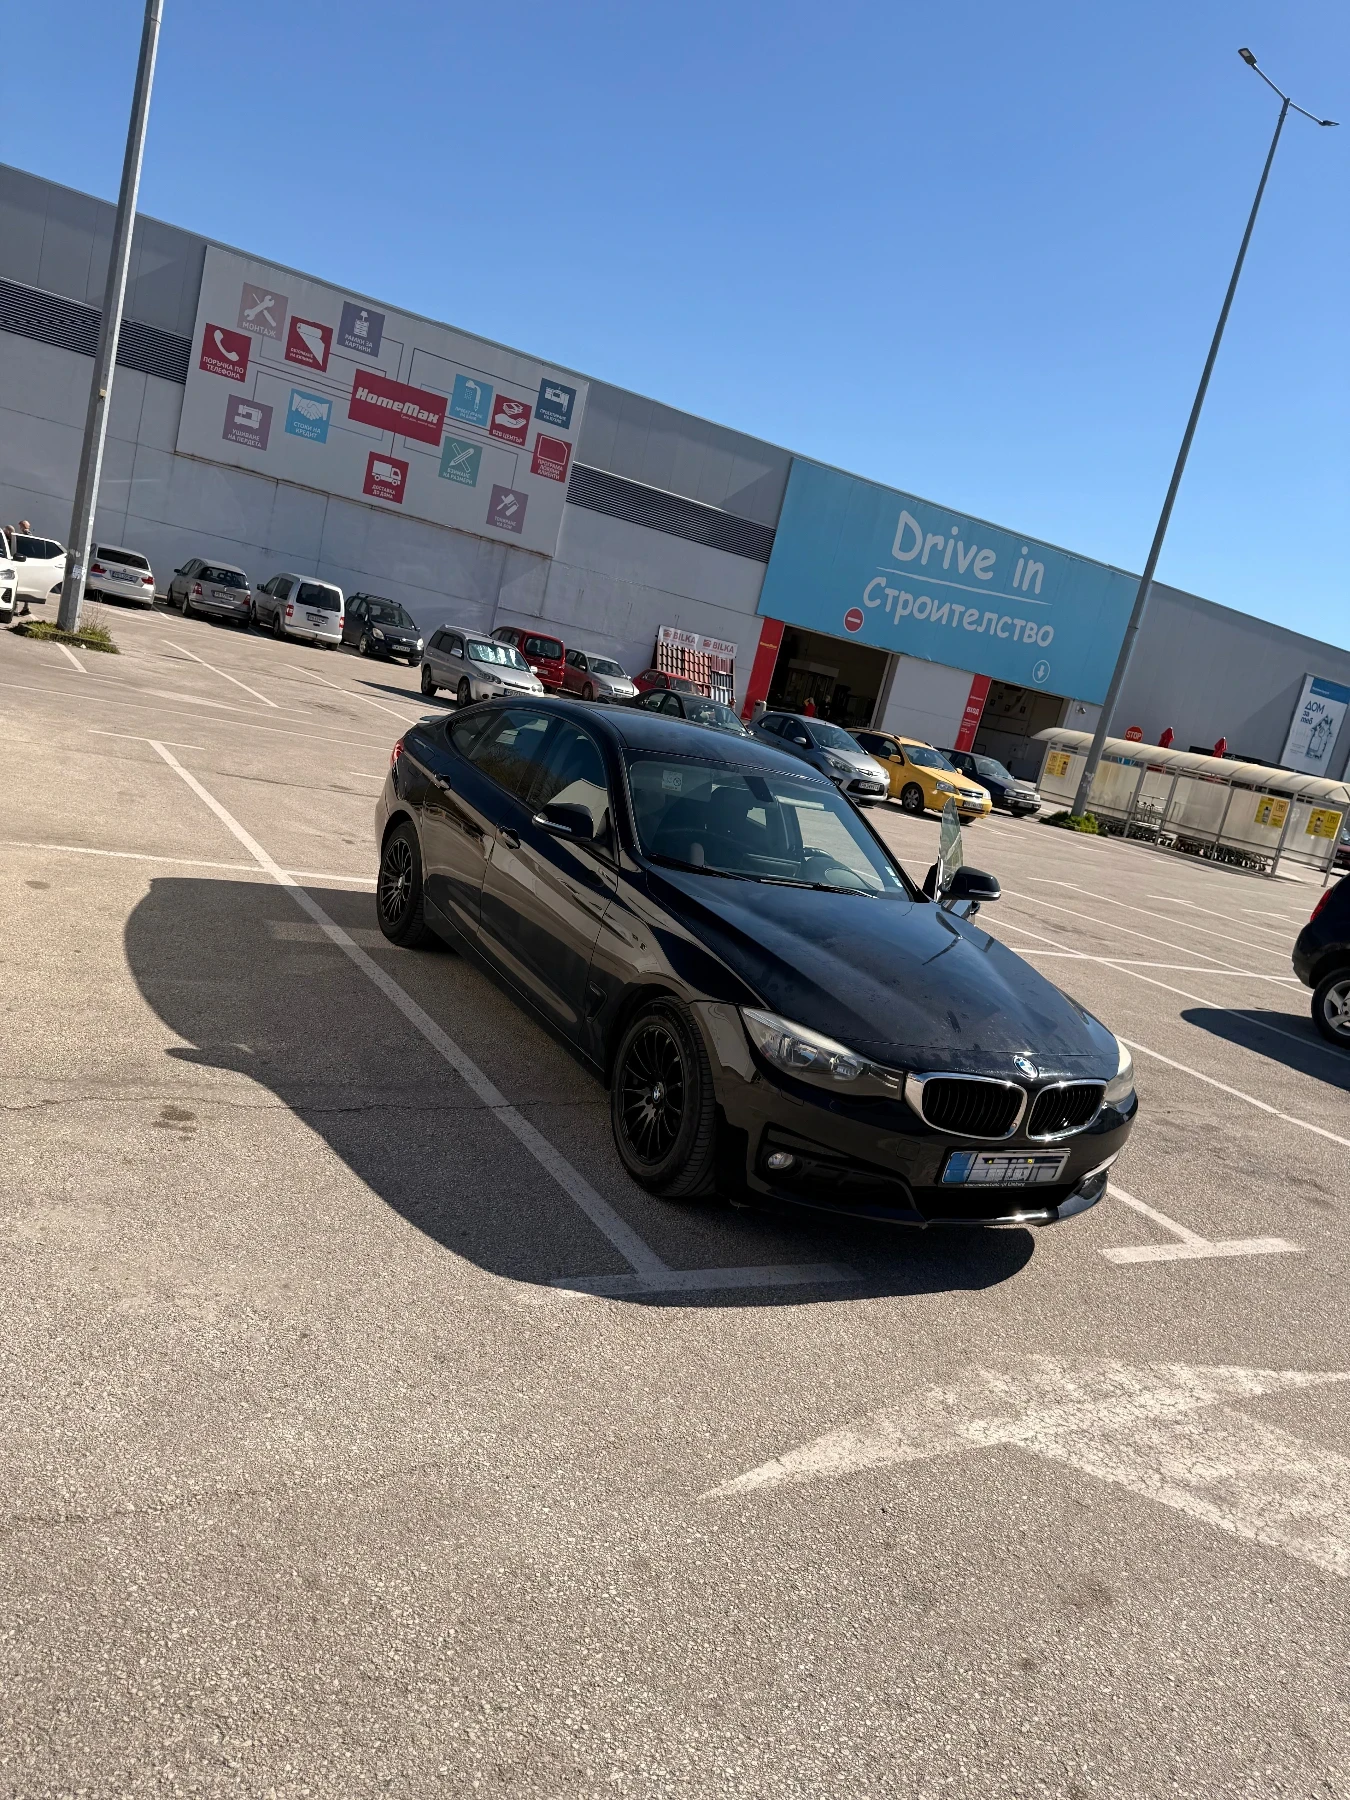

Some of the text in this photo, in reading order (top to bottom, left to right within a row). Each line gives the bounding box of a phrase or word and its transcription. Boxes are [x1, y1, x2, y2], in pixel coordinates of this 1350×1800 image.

[242, 322, 276, 338] МОНТАЖ
[345, 333, 365, 345] РАМКИ
[345, 340, 371, 353] КАРТИНИ
[202, 356, 244, 374] ПОРЪЧКА ПО
[206, 363, 240, 379] ТЕЛЕФОНА
[355, 386, 439, 424] HomeMax
[293, 421, 312, 431] СТОКИ
[232, 428, 260, 441] УШИВАНЕ
[295, 428, 317, 438] КРЕДИТ
[502, 433, 523, 443] ЦЕНТЪР
[236, 436, 262, 447] ПЕРДЕТА
[371, 484, 396, 495] ДОСТАВКА
[891, 510, 1045, 595] Drive in
[863, 576, 1055, 647] Строителство
[673, 631, 696, 643] BILKA
[712, 641, 734, 654] BILKA
[1304, 700, 1326, 715] ДОМ
[1126, 731, 1142, 740] STOP
